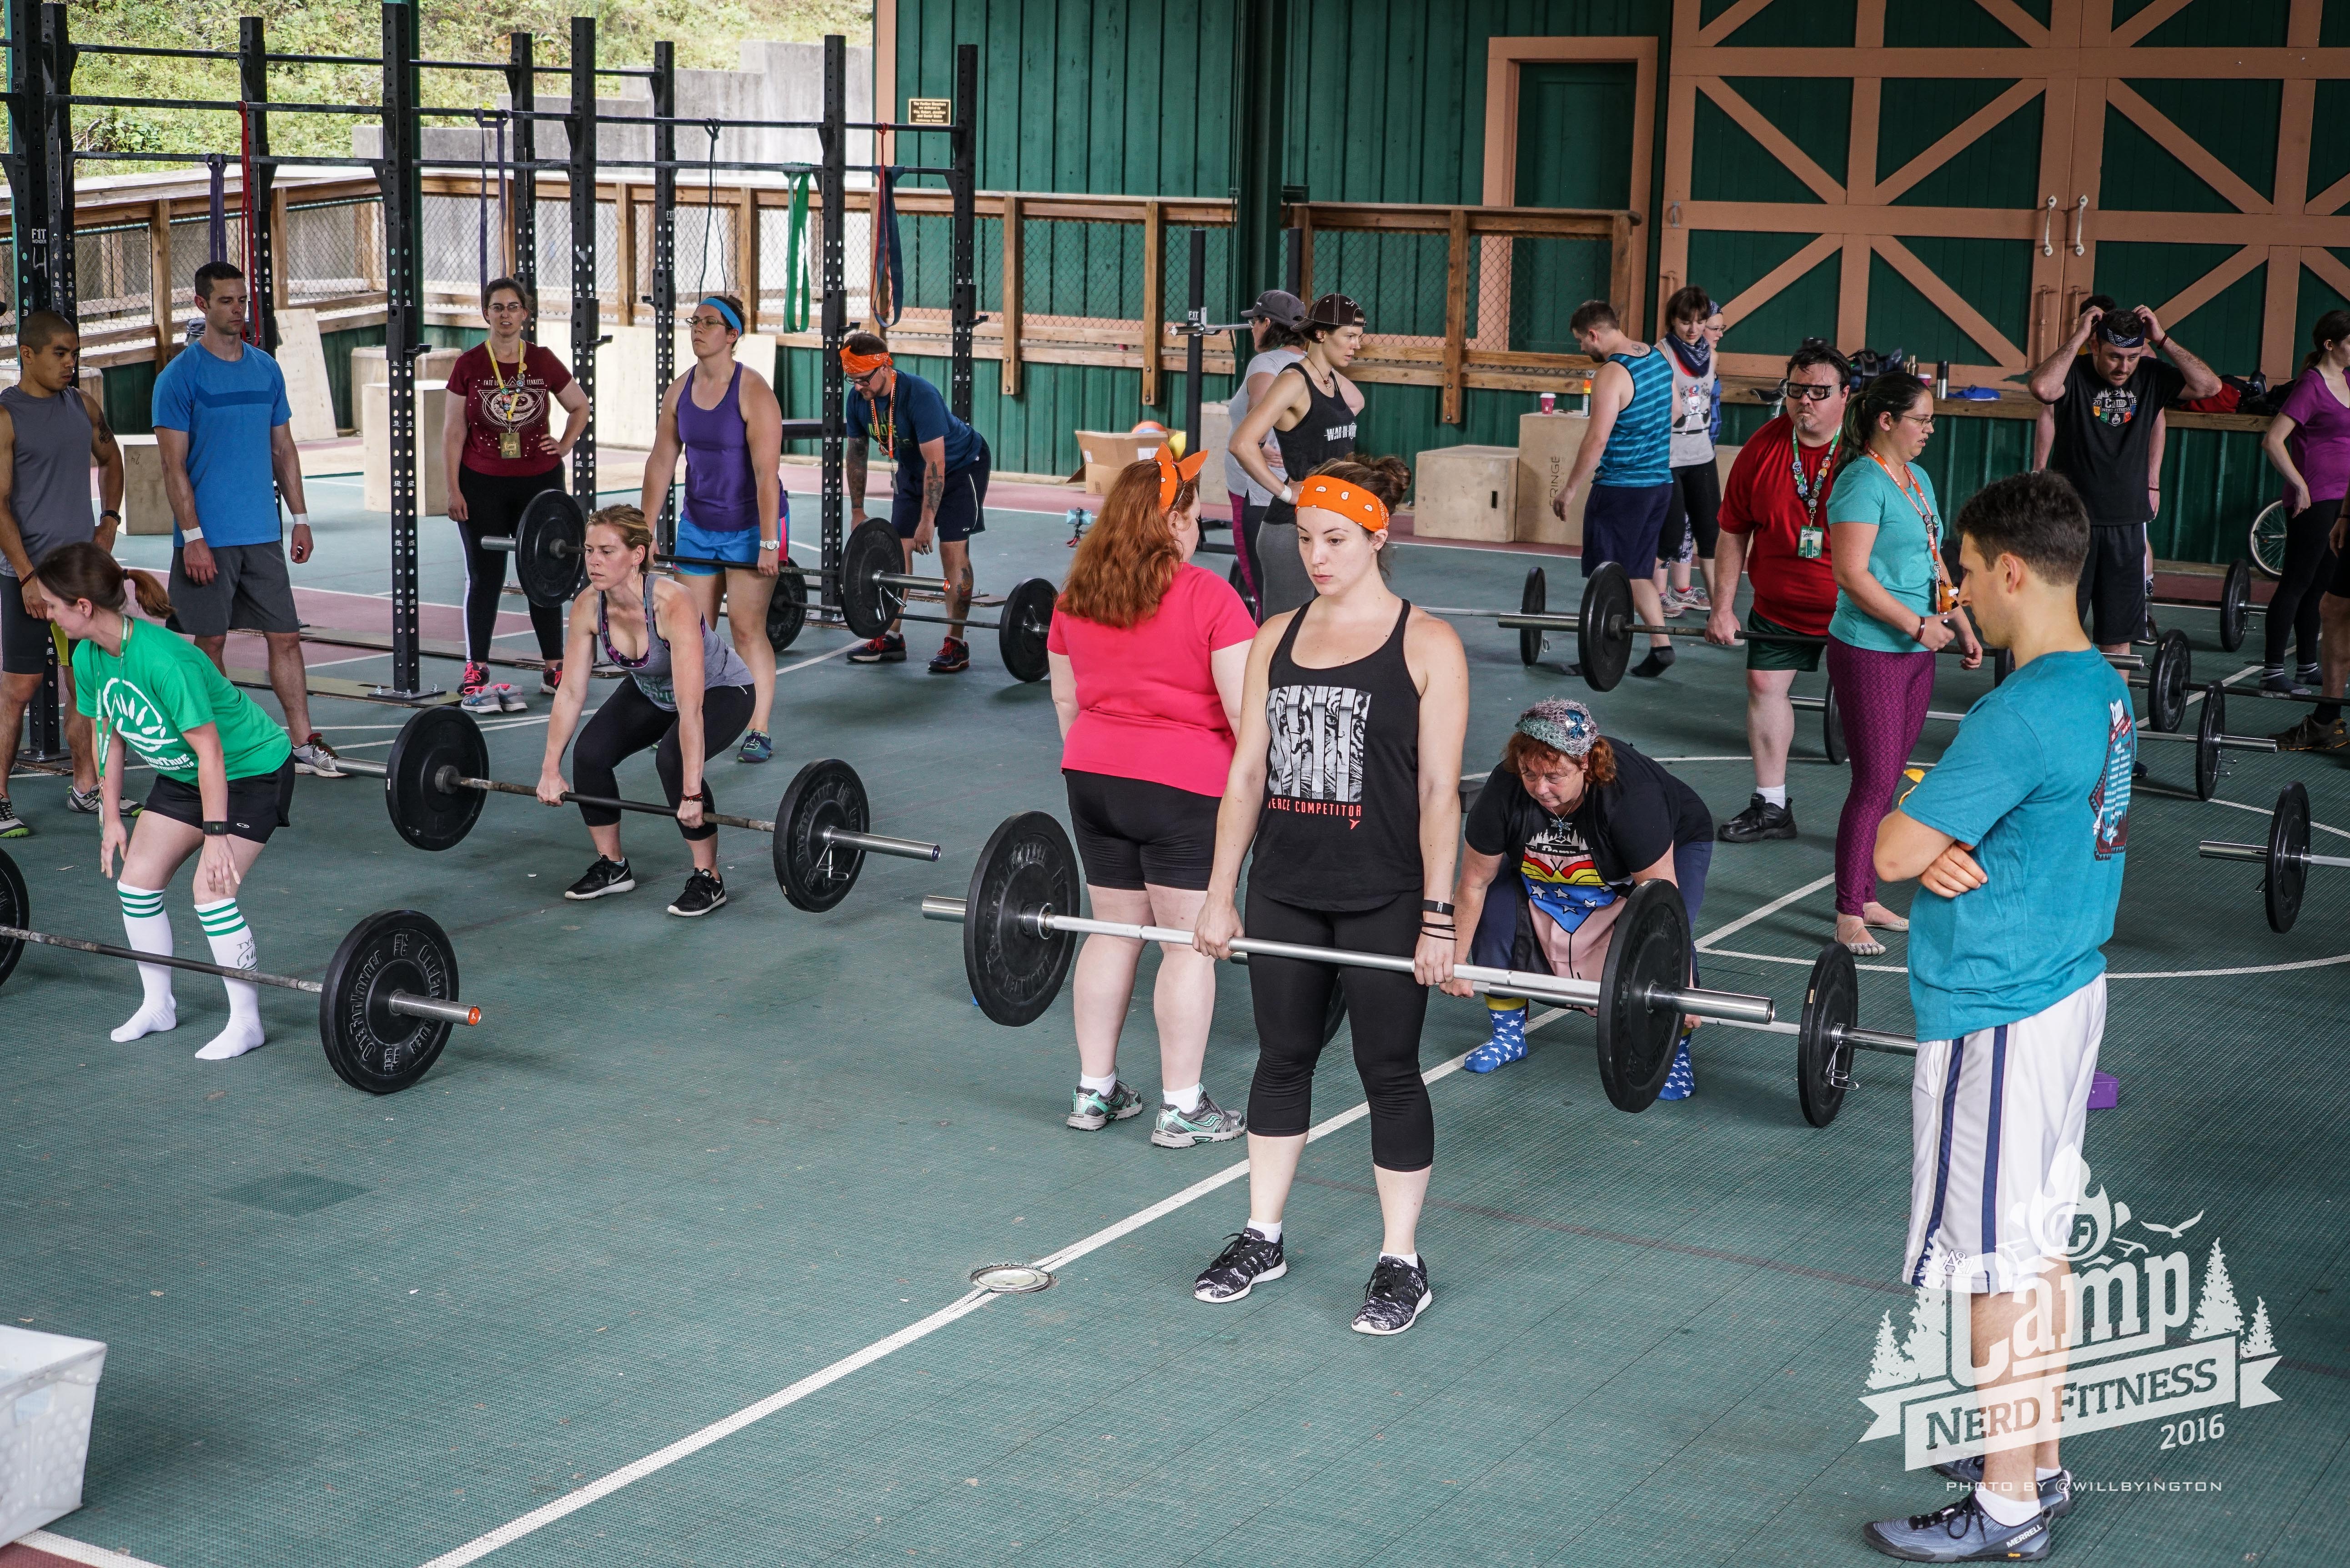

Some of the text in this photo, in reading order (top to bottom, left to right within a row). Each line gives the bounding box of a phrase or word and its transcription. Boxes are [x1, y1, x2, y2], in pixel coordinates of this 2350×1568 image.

[2105, 398, 2127, 408] Camp
[1295, 801, 1361, 817] COMPETITOR
[2006, 1524, 2043, 1548] MERRELL
